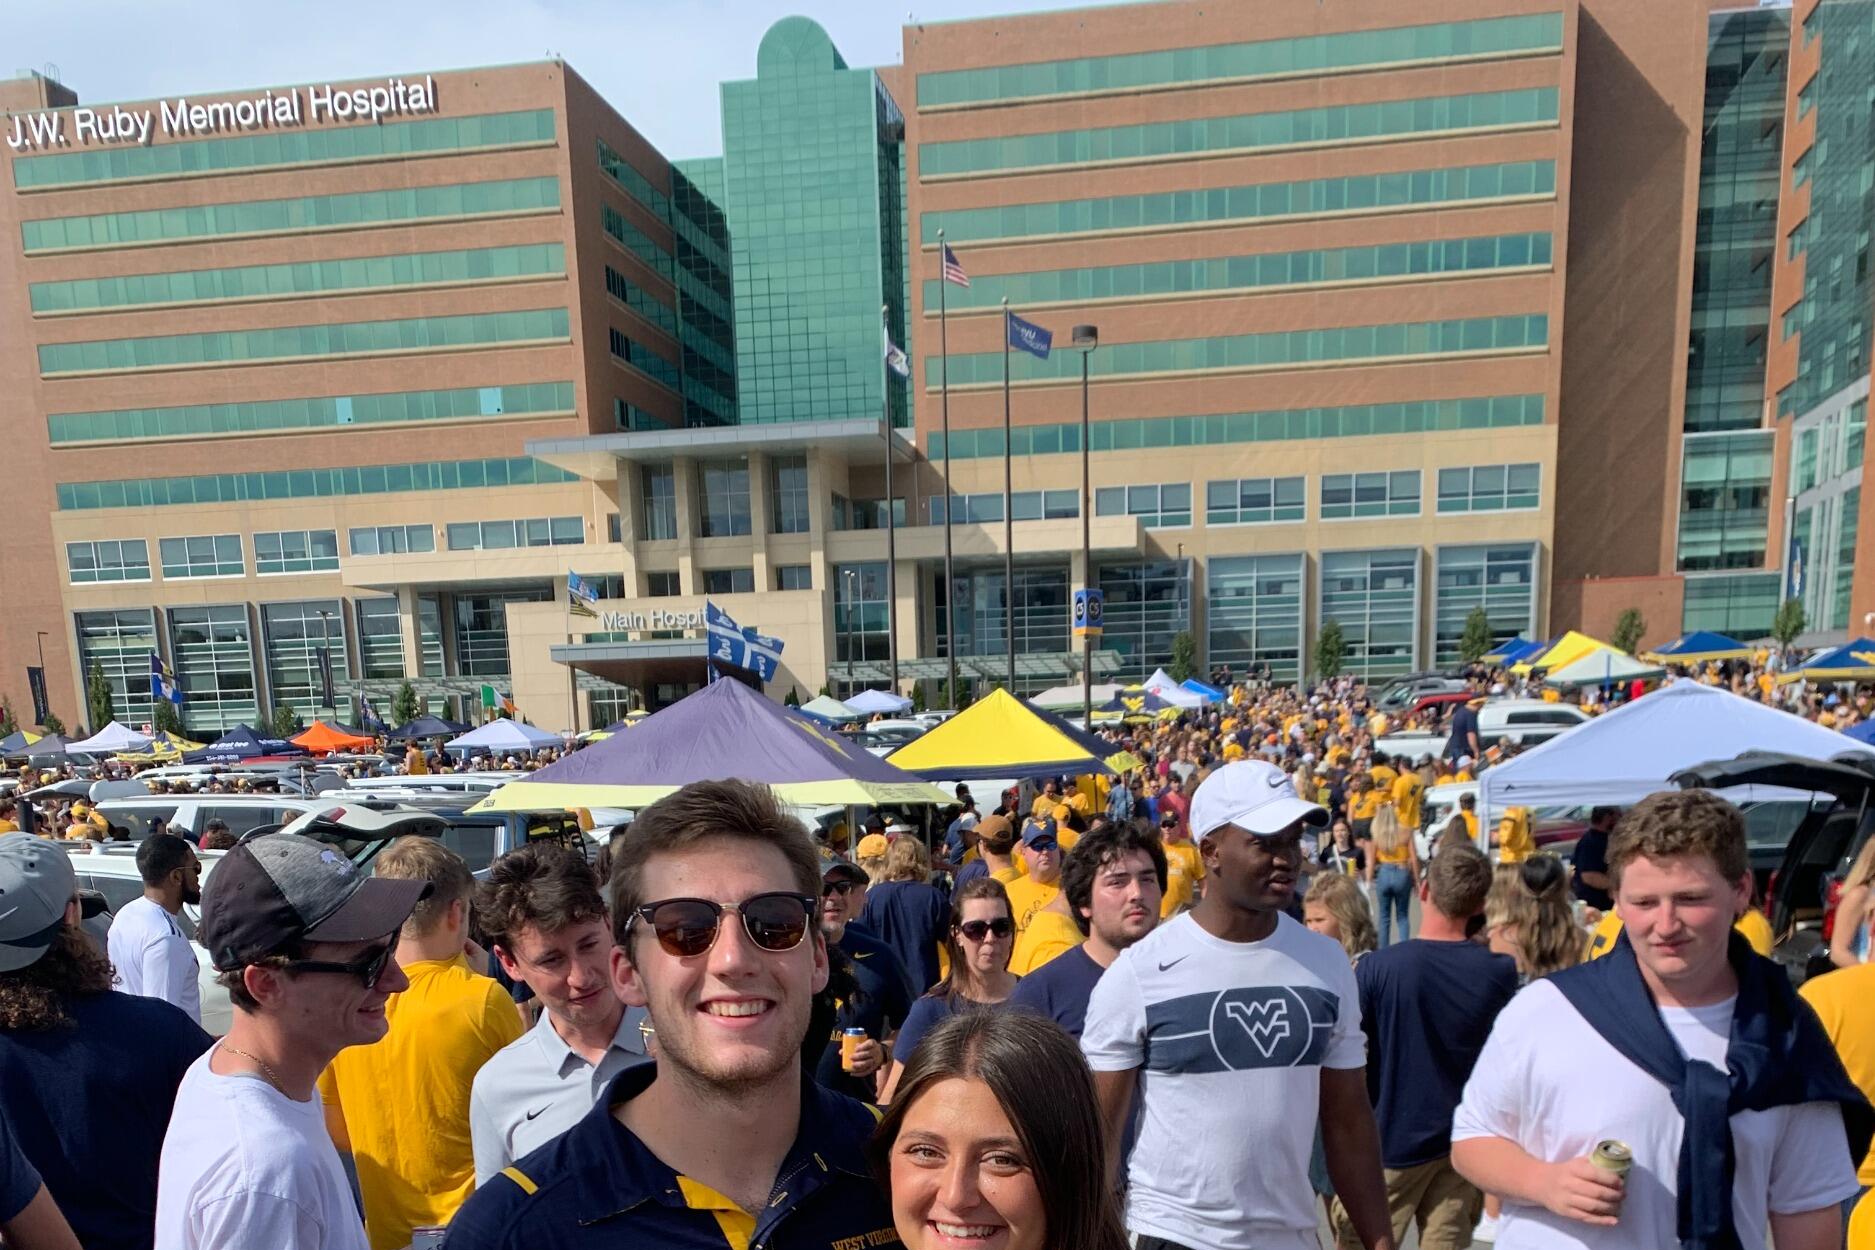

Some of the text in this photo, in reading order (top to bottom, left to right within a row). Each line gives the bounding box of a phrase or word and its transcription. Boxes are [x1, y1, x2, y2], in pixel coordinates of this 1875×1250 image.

[6, 75, 435, 149] J.W. Ruby Memorial Hospital
[602, 607, 708, 630] Main Hospit
